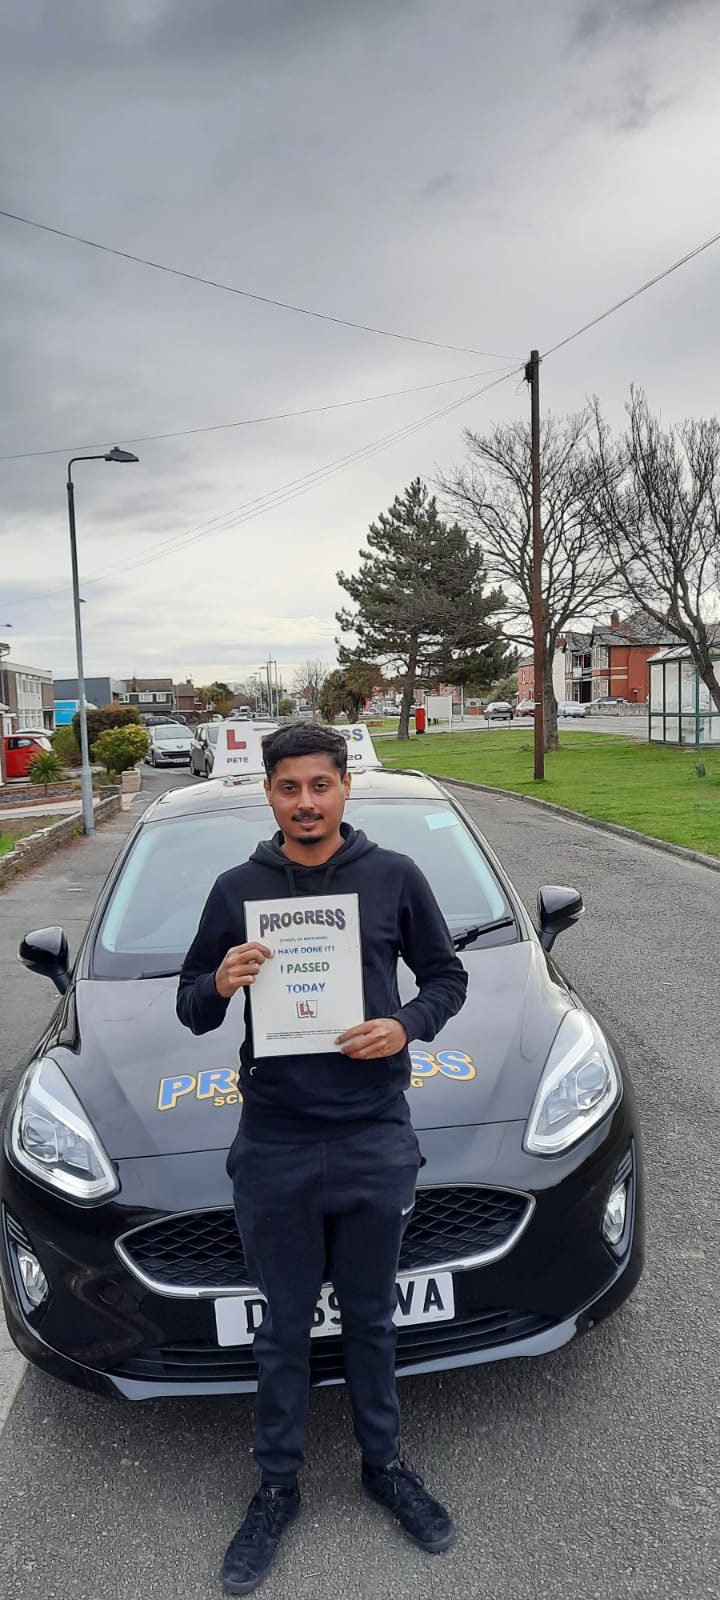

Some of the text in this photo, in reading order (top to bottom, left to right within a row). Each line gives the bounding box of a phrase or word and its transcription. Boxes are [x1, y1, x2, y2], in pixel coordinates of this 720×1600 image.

[226, 729, 247, 750] L
[226, 756, 249, 764] PETE
[259, 908, 346, 938] PROGRESS
[278, 947, 299, 955] HAVE
[300, 945, 324, 954] DONE
[280, 961, 330, 974] I PASSED
[285, 982, 326, 994] TODAY
